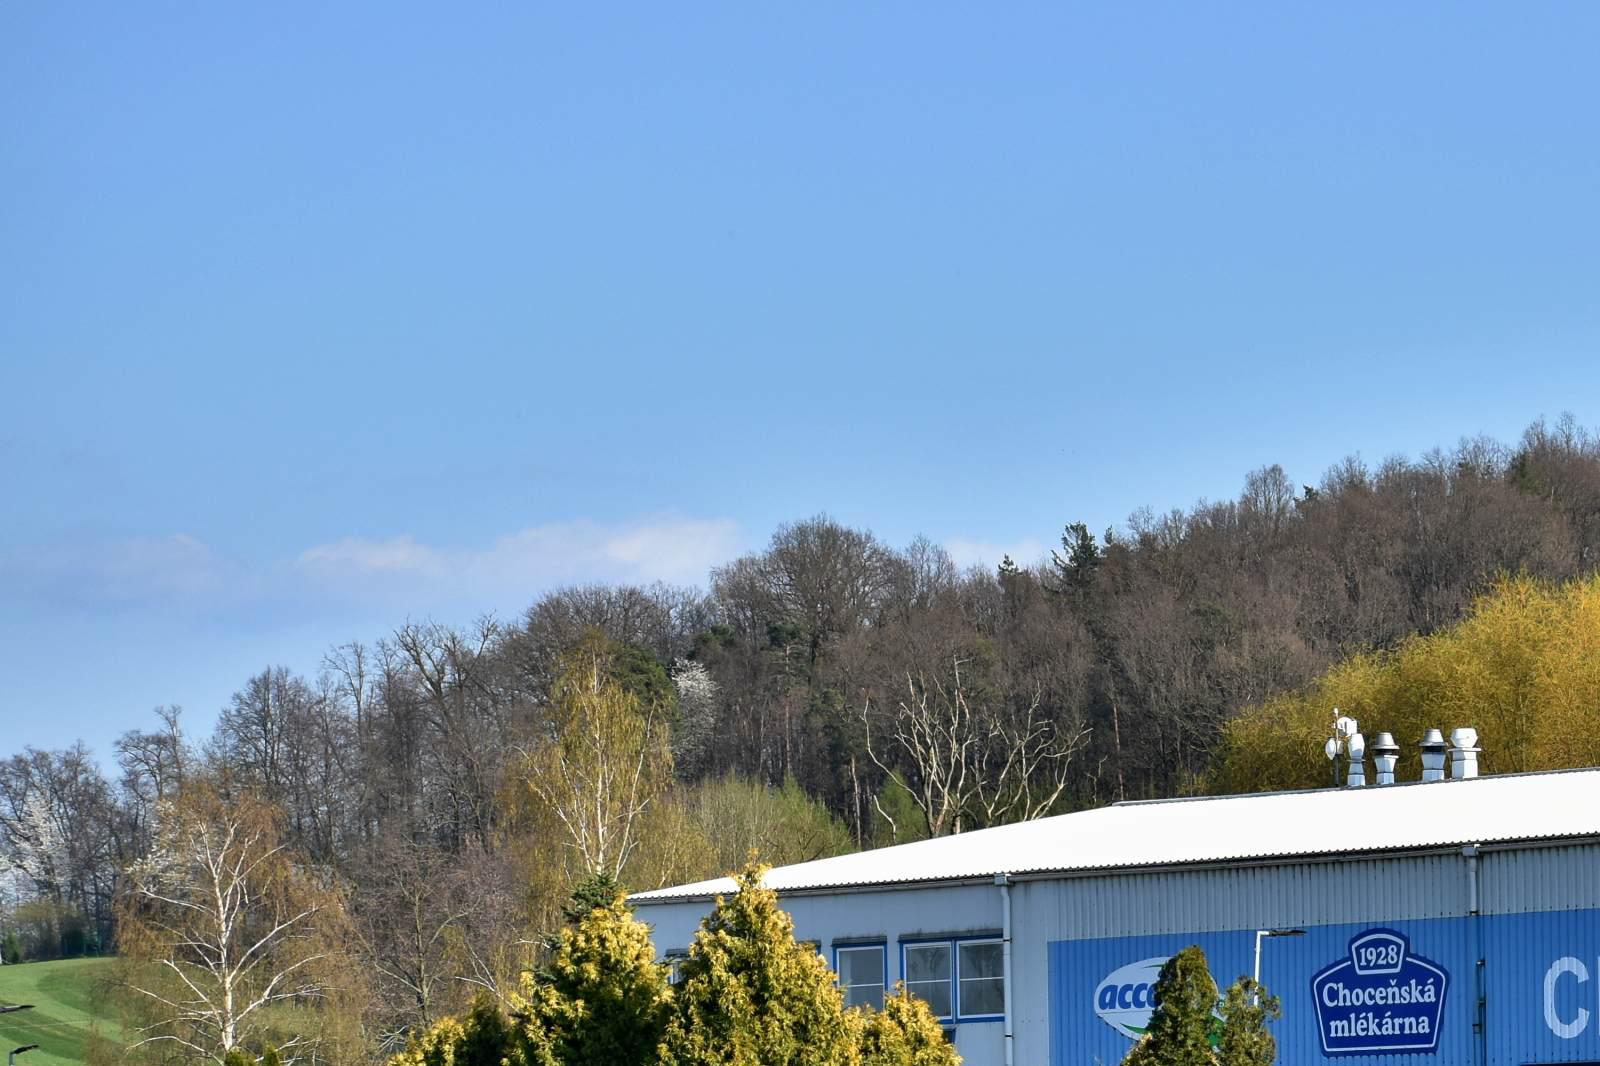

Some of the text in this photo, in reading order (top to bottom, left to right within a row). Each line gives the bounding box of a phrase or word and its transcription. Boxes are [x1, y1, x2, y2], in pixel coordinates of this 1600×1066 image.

[1359, 944, 1398, 967] 1928
[1098, 982, 1163, 1010] acco
[1322, 977, 1436, 1007] Choceňská
[1329, 1011, 1430, 1037] mlékárna
